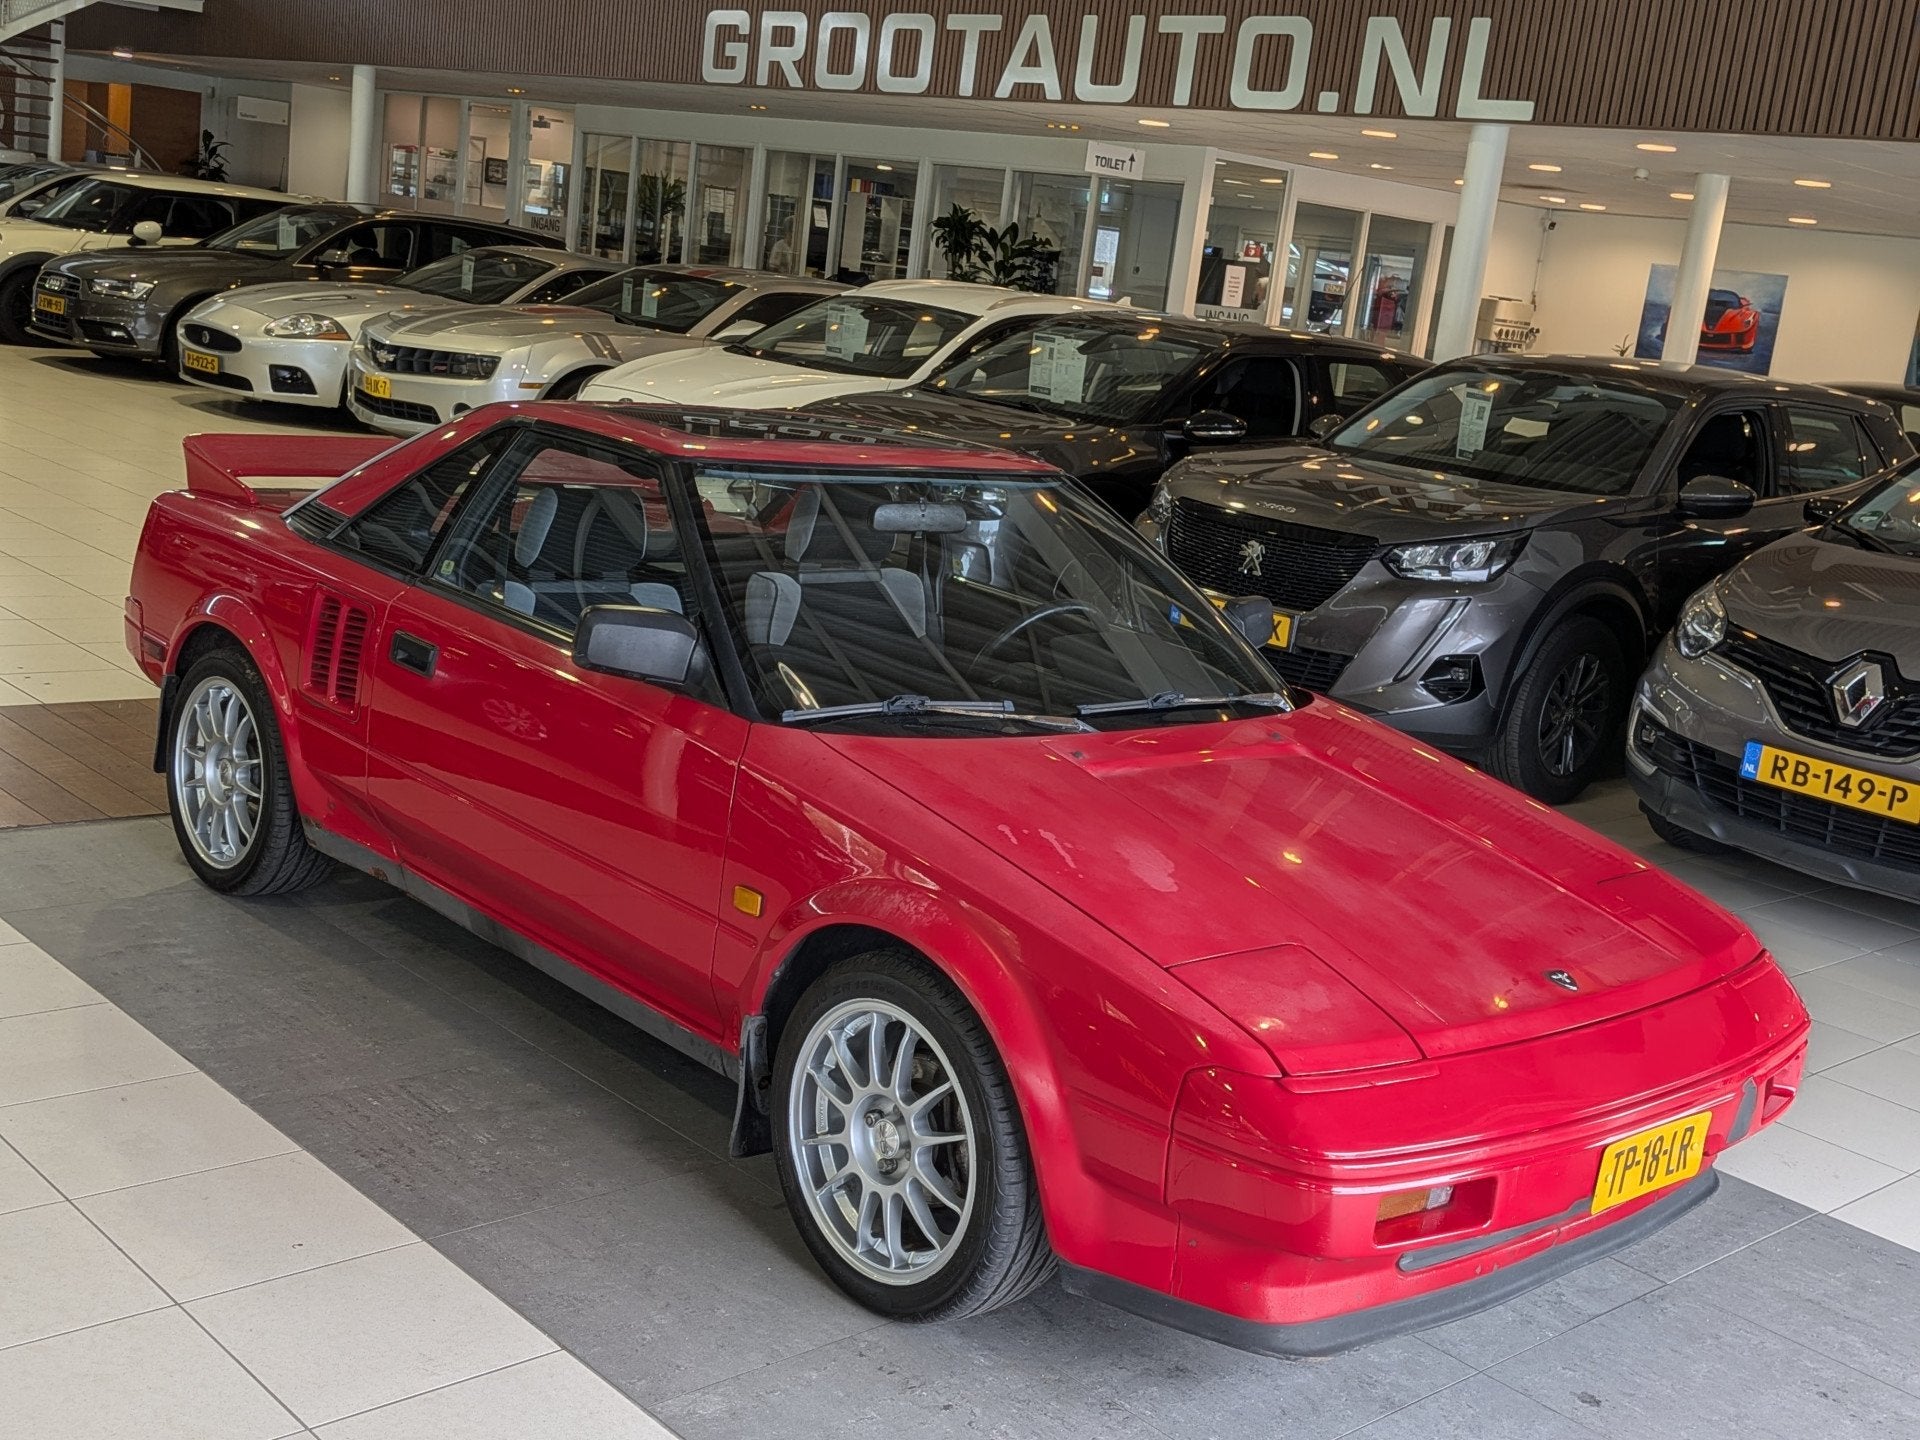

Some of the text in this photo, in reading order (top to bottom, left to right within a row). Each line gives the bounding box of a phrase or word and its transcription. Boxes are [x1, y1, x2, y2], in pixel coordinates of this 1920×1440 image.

[702, 9, 1535, 121] GROOTAUTO.NL
[1095, 154, 1127, 171] TOILET
[530, 215, 561, 233] INGANG
[1744, 754, 1909, 812] NL RB-149-P
[1608, 1125, 1695, 1198] TP-18-LR
